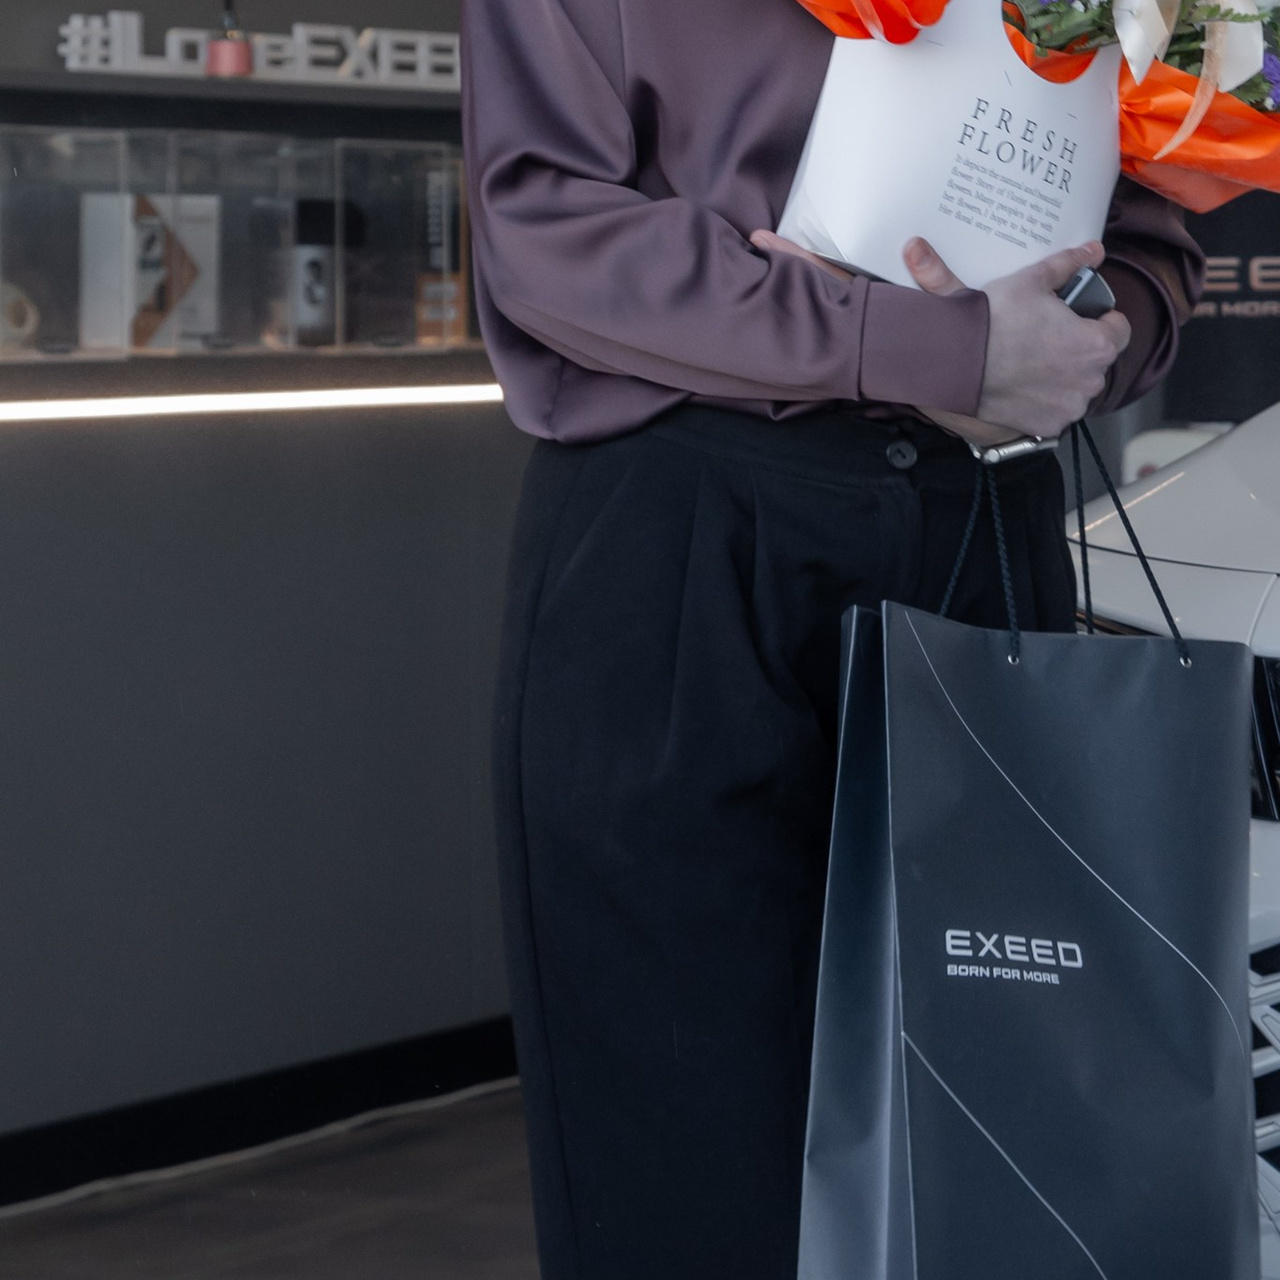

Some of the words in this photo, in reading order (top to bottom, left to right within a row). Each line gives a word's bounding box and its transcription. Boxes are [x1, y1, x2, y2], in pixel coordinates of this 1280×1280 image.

[970, 97, 1078, 164] FRESH
[957, 122, 1073, 194] FLOWER
[945, 929, 1083, 968] EXEED
[947, 964, 991, 978] BORN
[993, 967, 1021, 980] FOR
[1022, 970, 1060, 985] MORE
